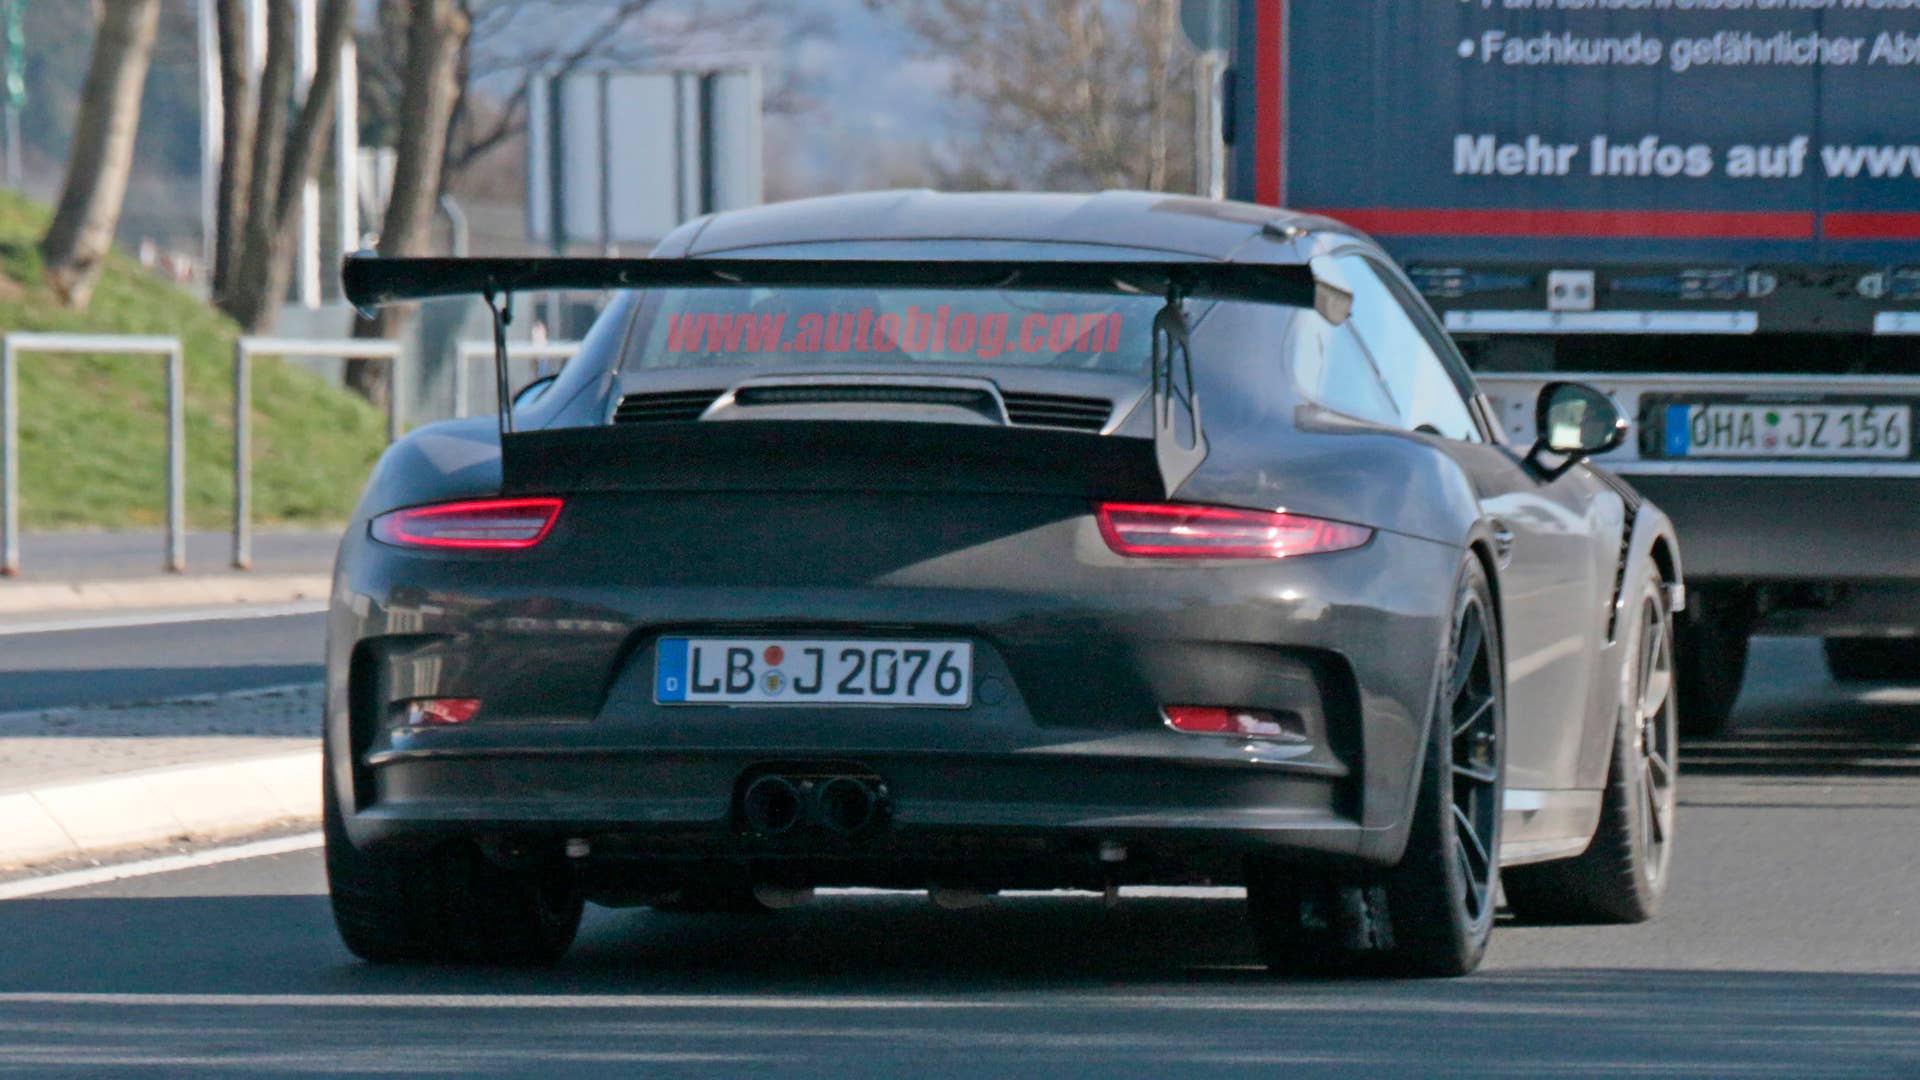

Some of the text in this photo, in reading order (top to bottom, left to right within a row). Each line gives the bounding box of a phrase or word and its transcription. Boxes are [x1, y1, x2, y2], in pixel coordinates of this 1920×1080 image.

[1481, 30, 1662, 65] Fachkunde
[1670, 30, 1865, 72] gefährlicher
[1453, 134, 1578, 176] Mehr
[1590, 135, 1713, 177] Infos
[1725, 135, 1809, 178] auf
[1787, 412, 1828, 447] JZ
[1839, 413, 1901, 448] 156
[692, 647, 962, 696] LB J 2076
